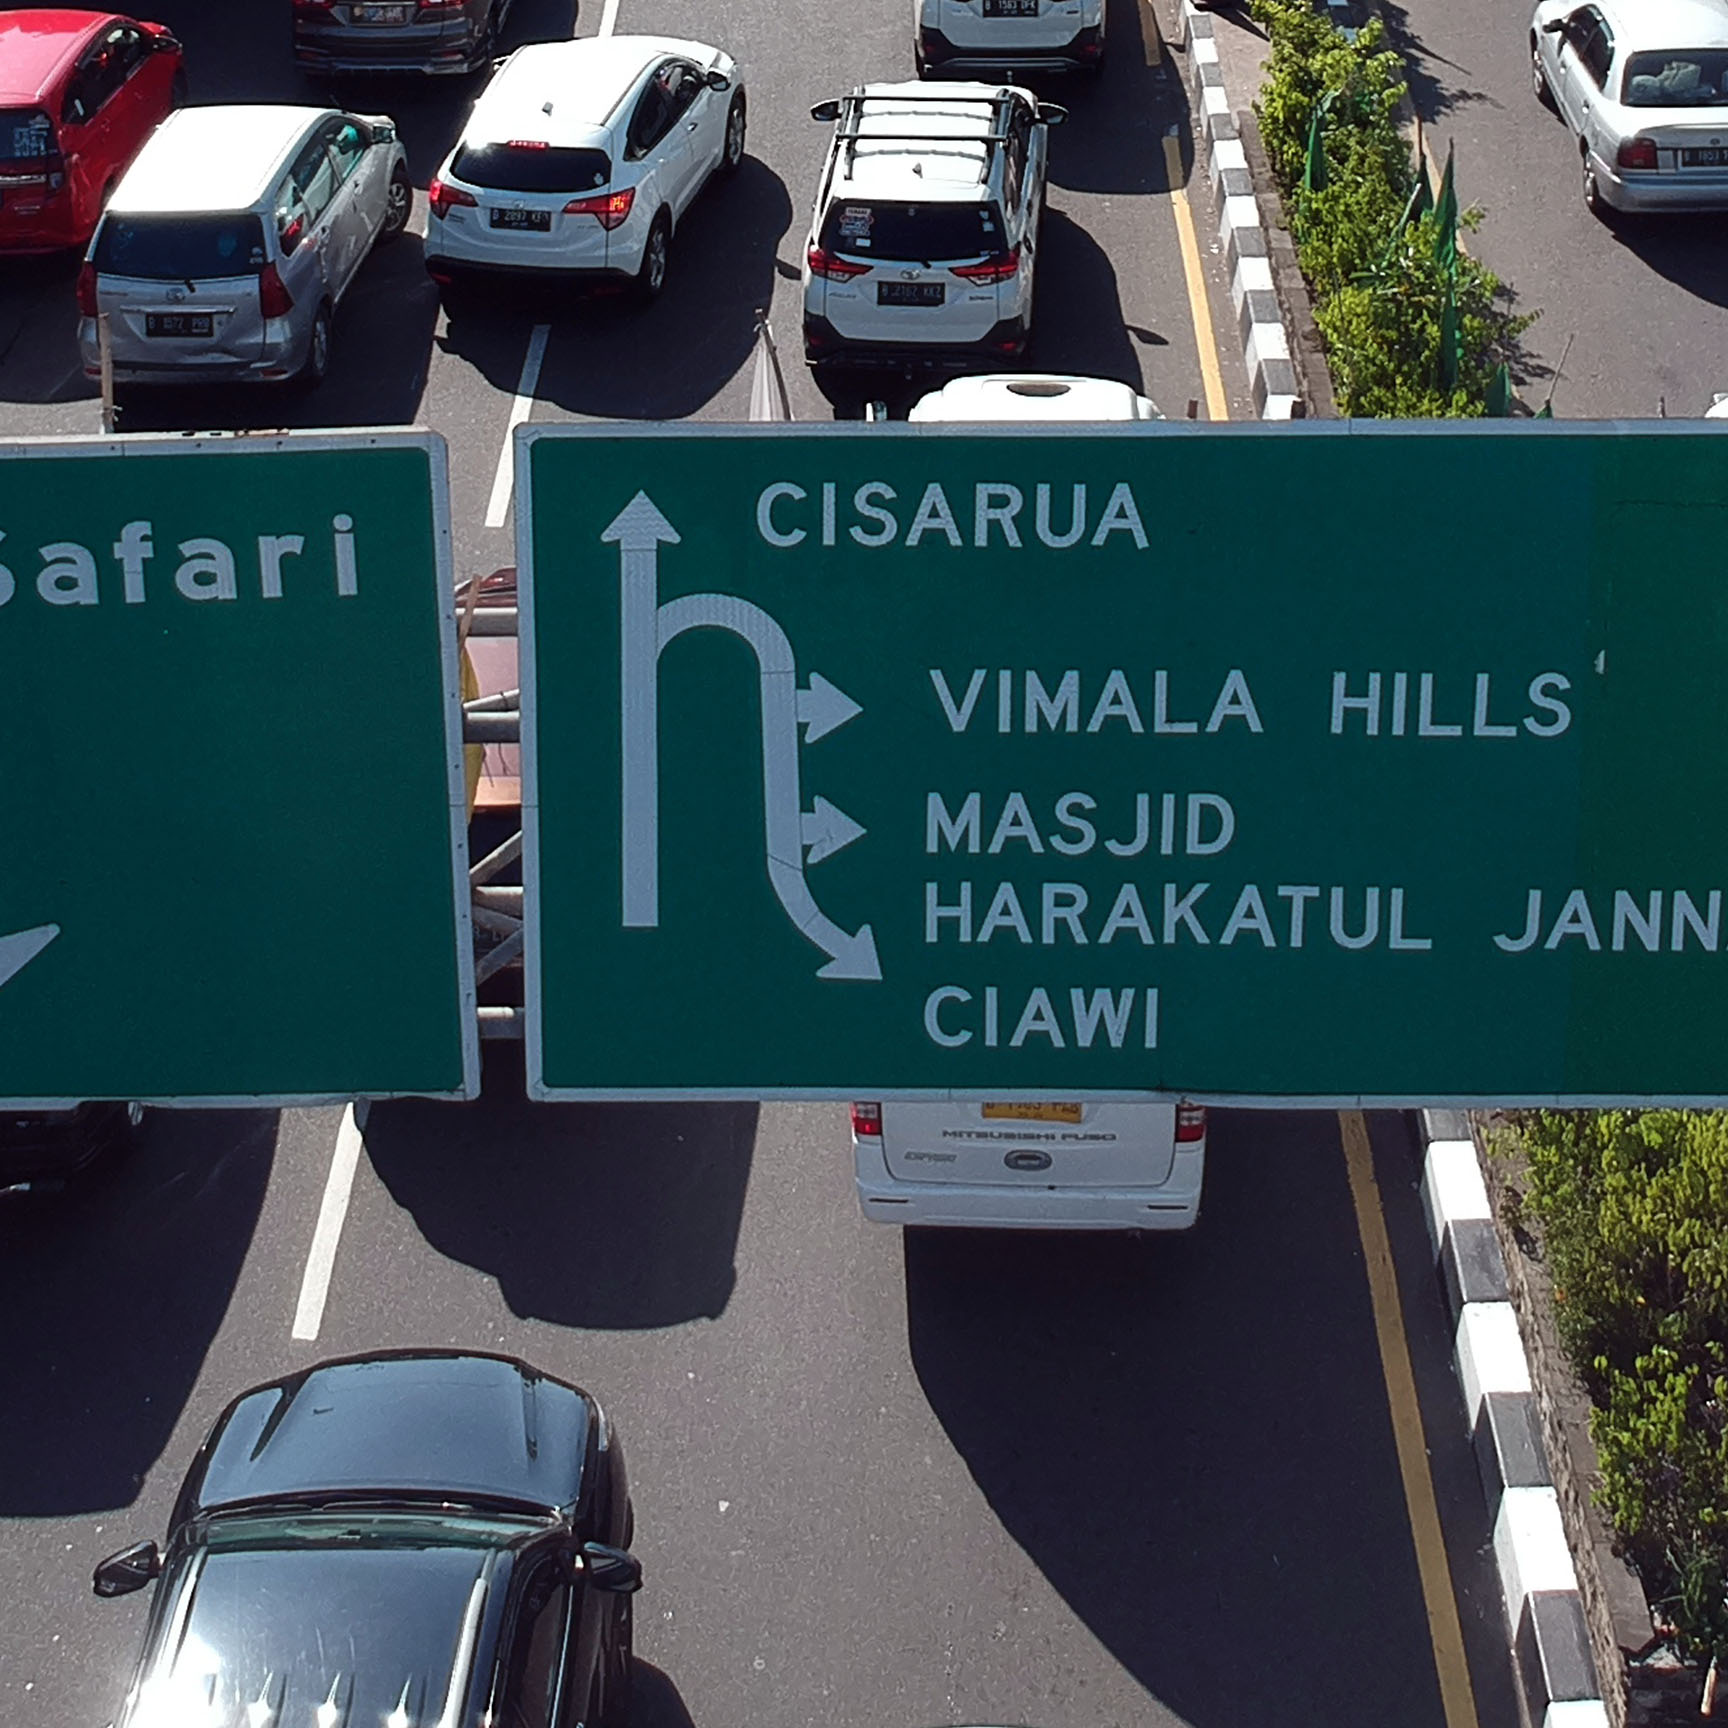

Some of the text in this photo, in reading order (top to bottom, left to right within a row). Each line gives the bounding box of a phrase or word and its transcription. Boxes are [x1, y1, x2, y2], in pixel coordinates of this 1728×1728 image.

[757, 481, 1149, 550] CISARUA
[929, 668, 1572, 737] VIMALA HILLS
[926, 792, 1235, 856] MASJID
[925, 881, 1432, 950] HARAKATUL
[924, 985, 1159, 1049] CIAWI
[942, 1129, 1118, 1143] MITSUBISHI FUSO
